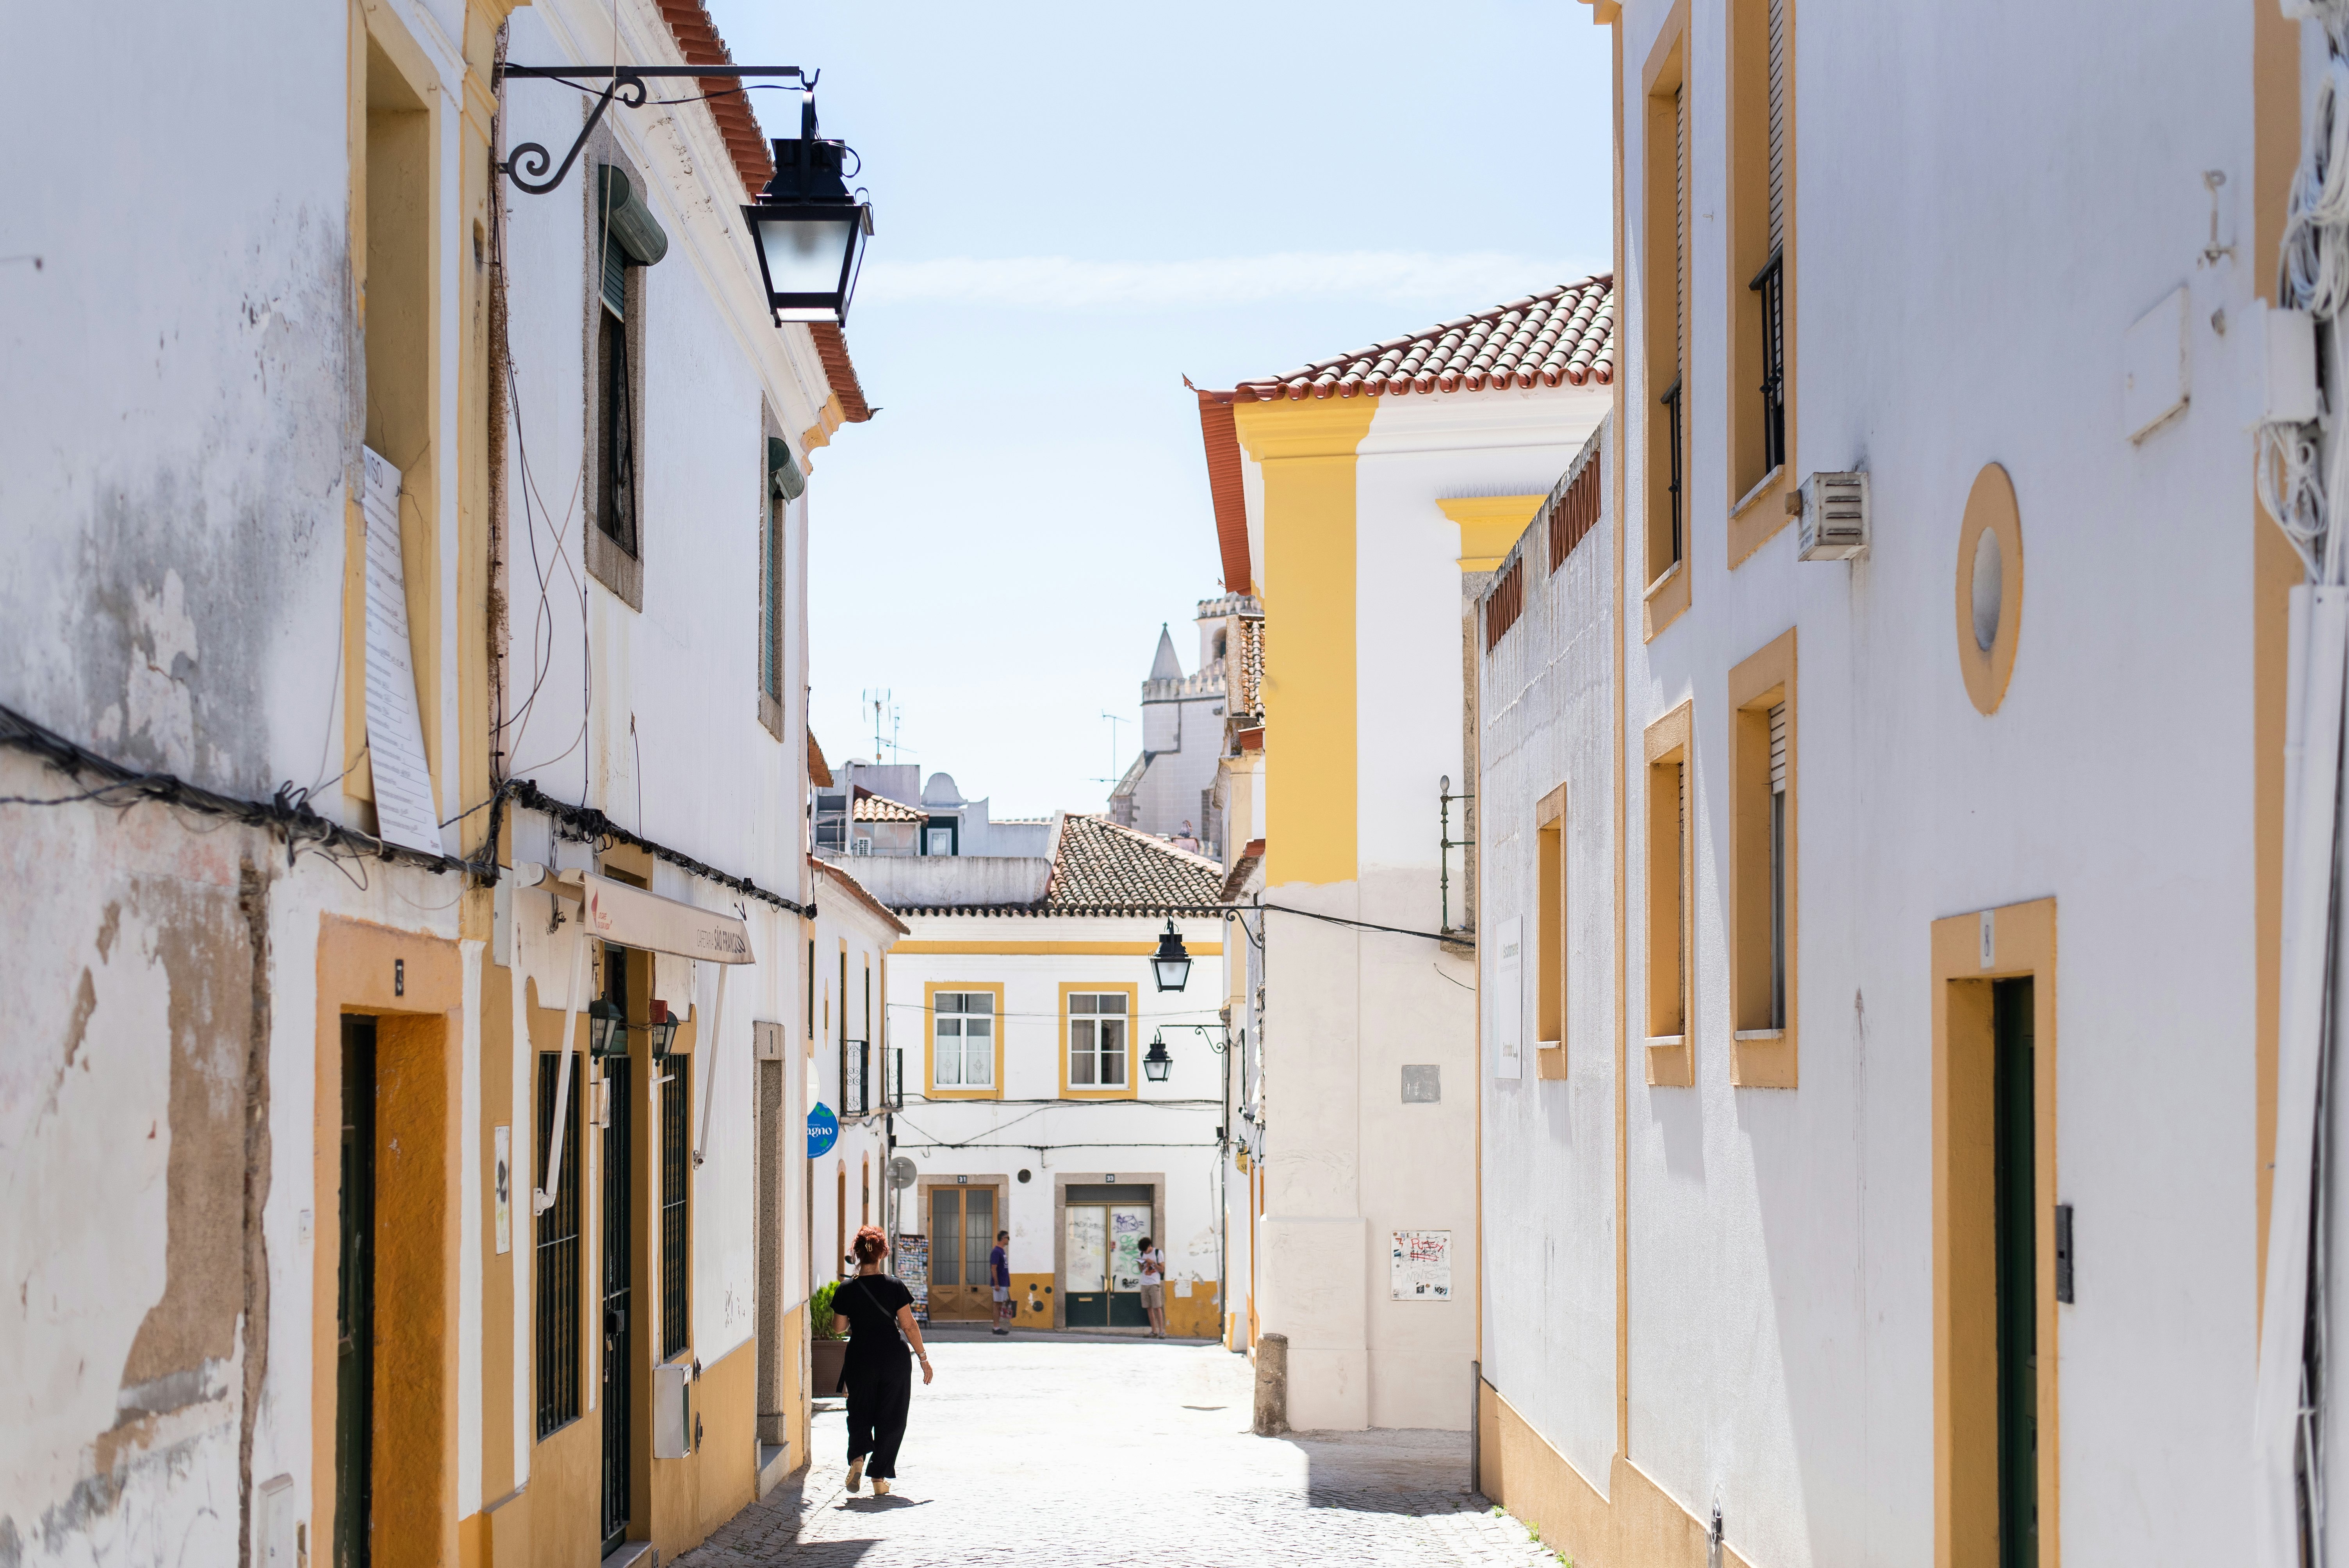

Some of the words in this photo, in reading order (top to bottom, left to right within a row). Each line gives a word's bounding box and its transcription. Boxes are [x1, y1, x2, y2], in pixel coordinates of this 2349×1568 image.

[697, 929, 714, 950] CAFETARIA
[714, 925, 722, 951] SÃO
[1503, 1041, 1512, 1057] Entrada
[1410, 1238, 1444, 1252] PUSSY
